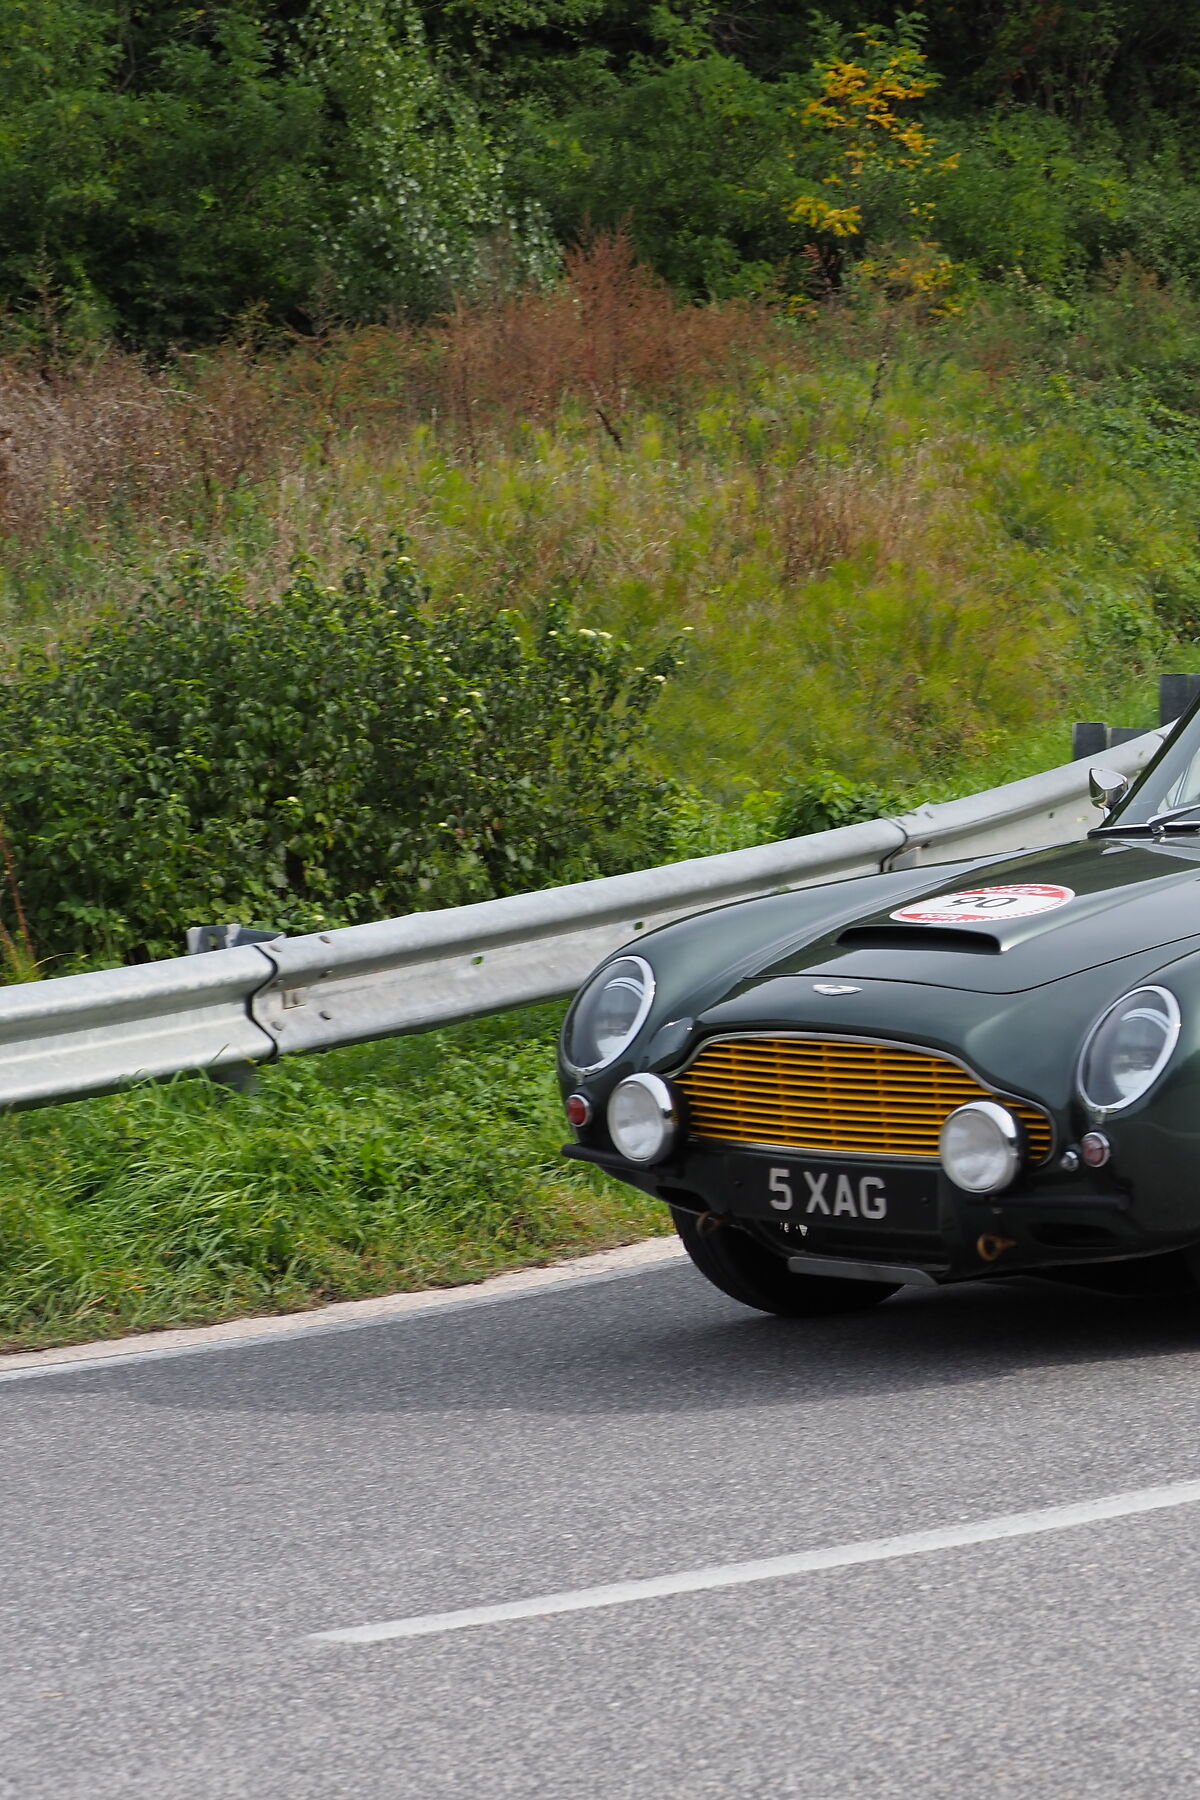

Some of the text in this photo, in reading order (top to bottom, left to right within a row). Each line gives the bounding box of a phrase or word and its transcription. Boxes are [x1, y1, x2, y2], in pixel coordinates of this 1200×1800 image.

[943, 896, 1018, 908] 90
[769, 1167, 888, 1220] 5 XAG
